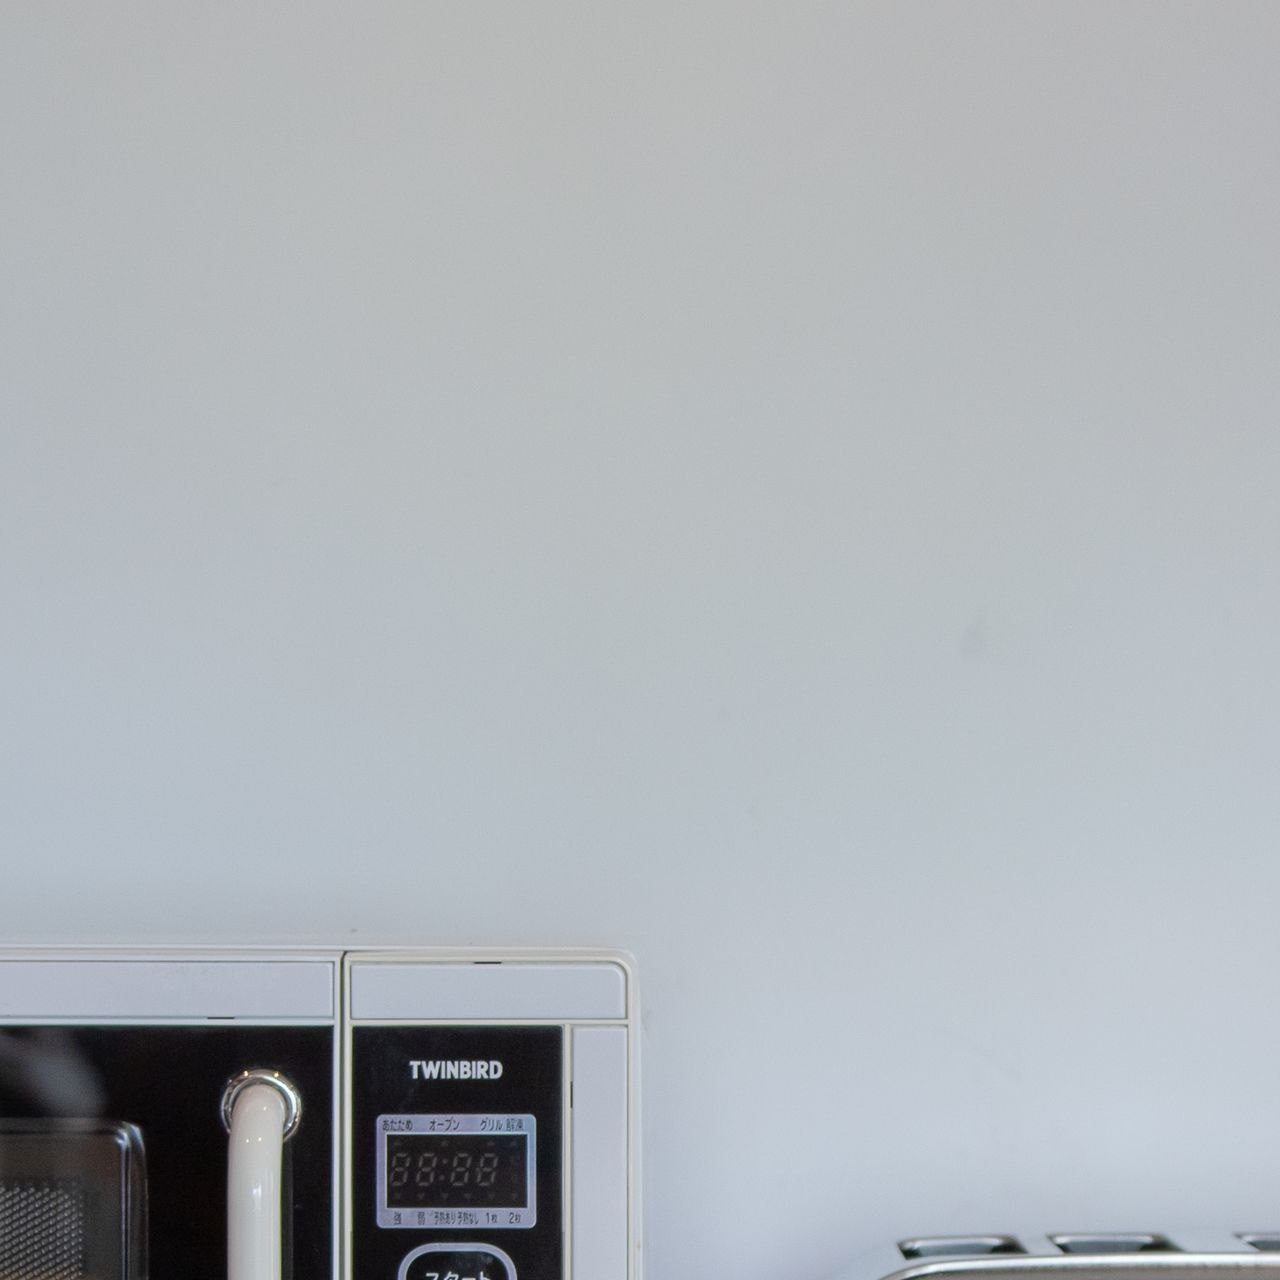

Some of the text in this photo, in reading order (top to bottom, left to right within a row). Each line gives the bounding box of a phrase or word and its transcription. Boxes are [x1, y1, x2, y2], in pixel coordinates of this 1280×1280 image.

[409, 1060, 503, 1080] TWINBIRD
[382, 1118, 413, 1131] あたため
[429, 1116, 460, 1131] オープン
[480, 1116, 503, 1131] グリル
